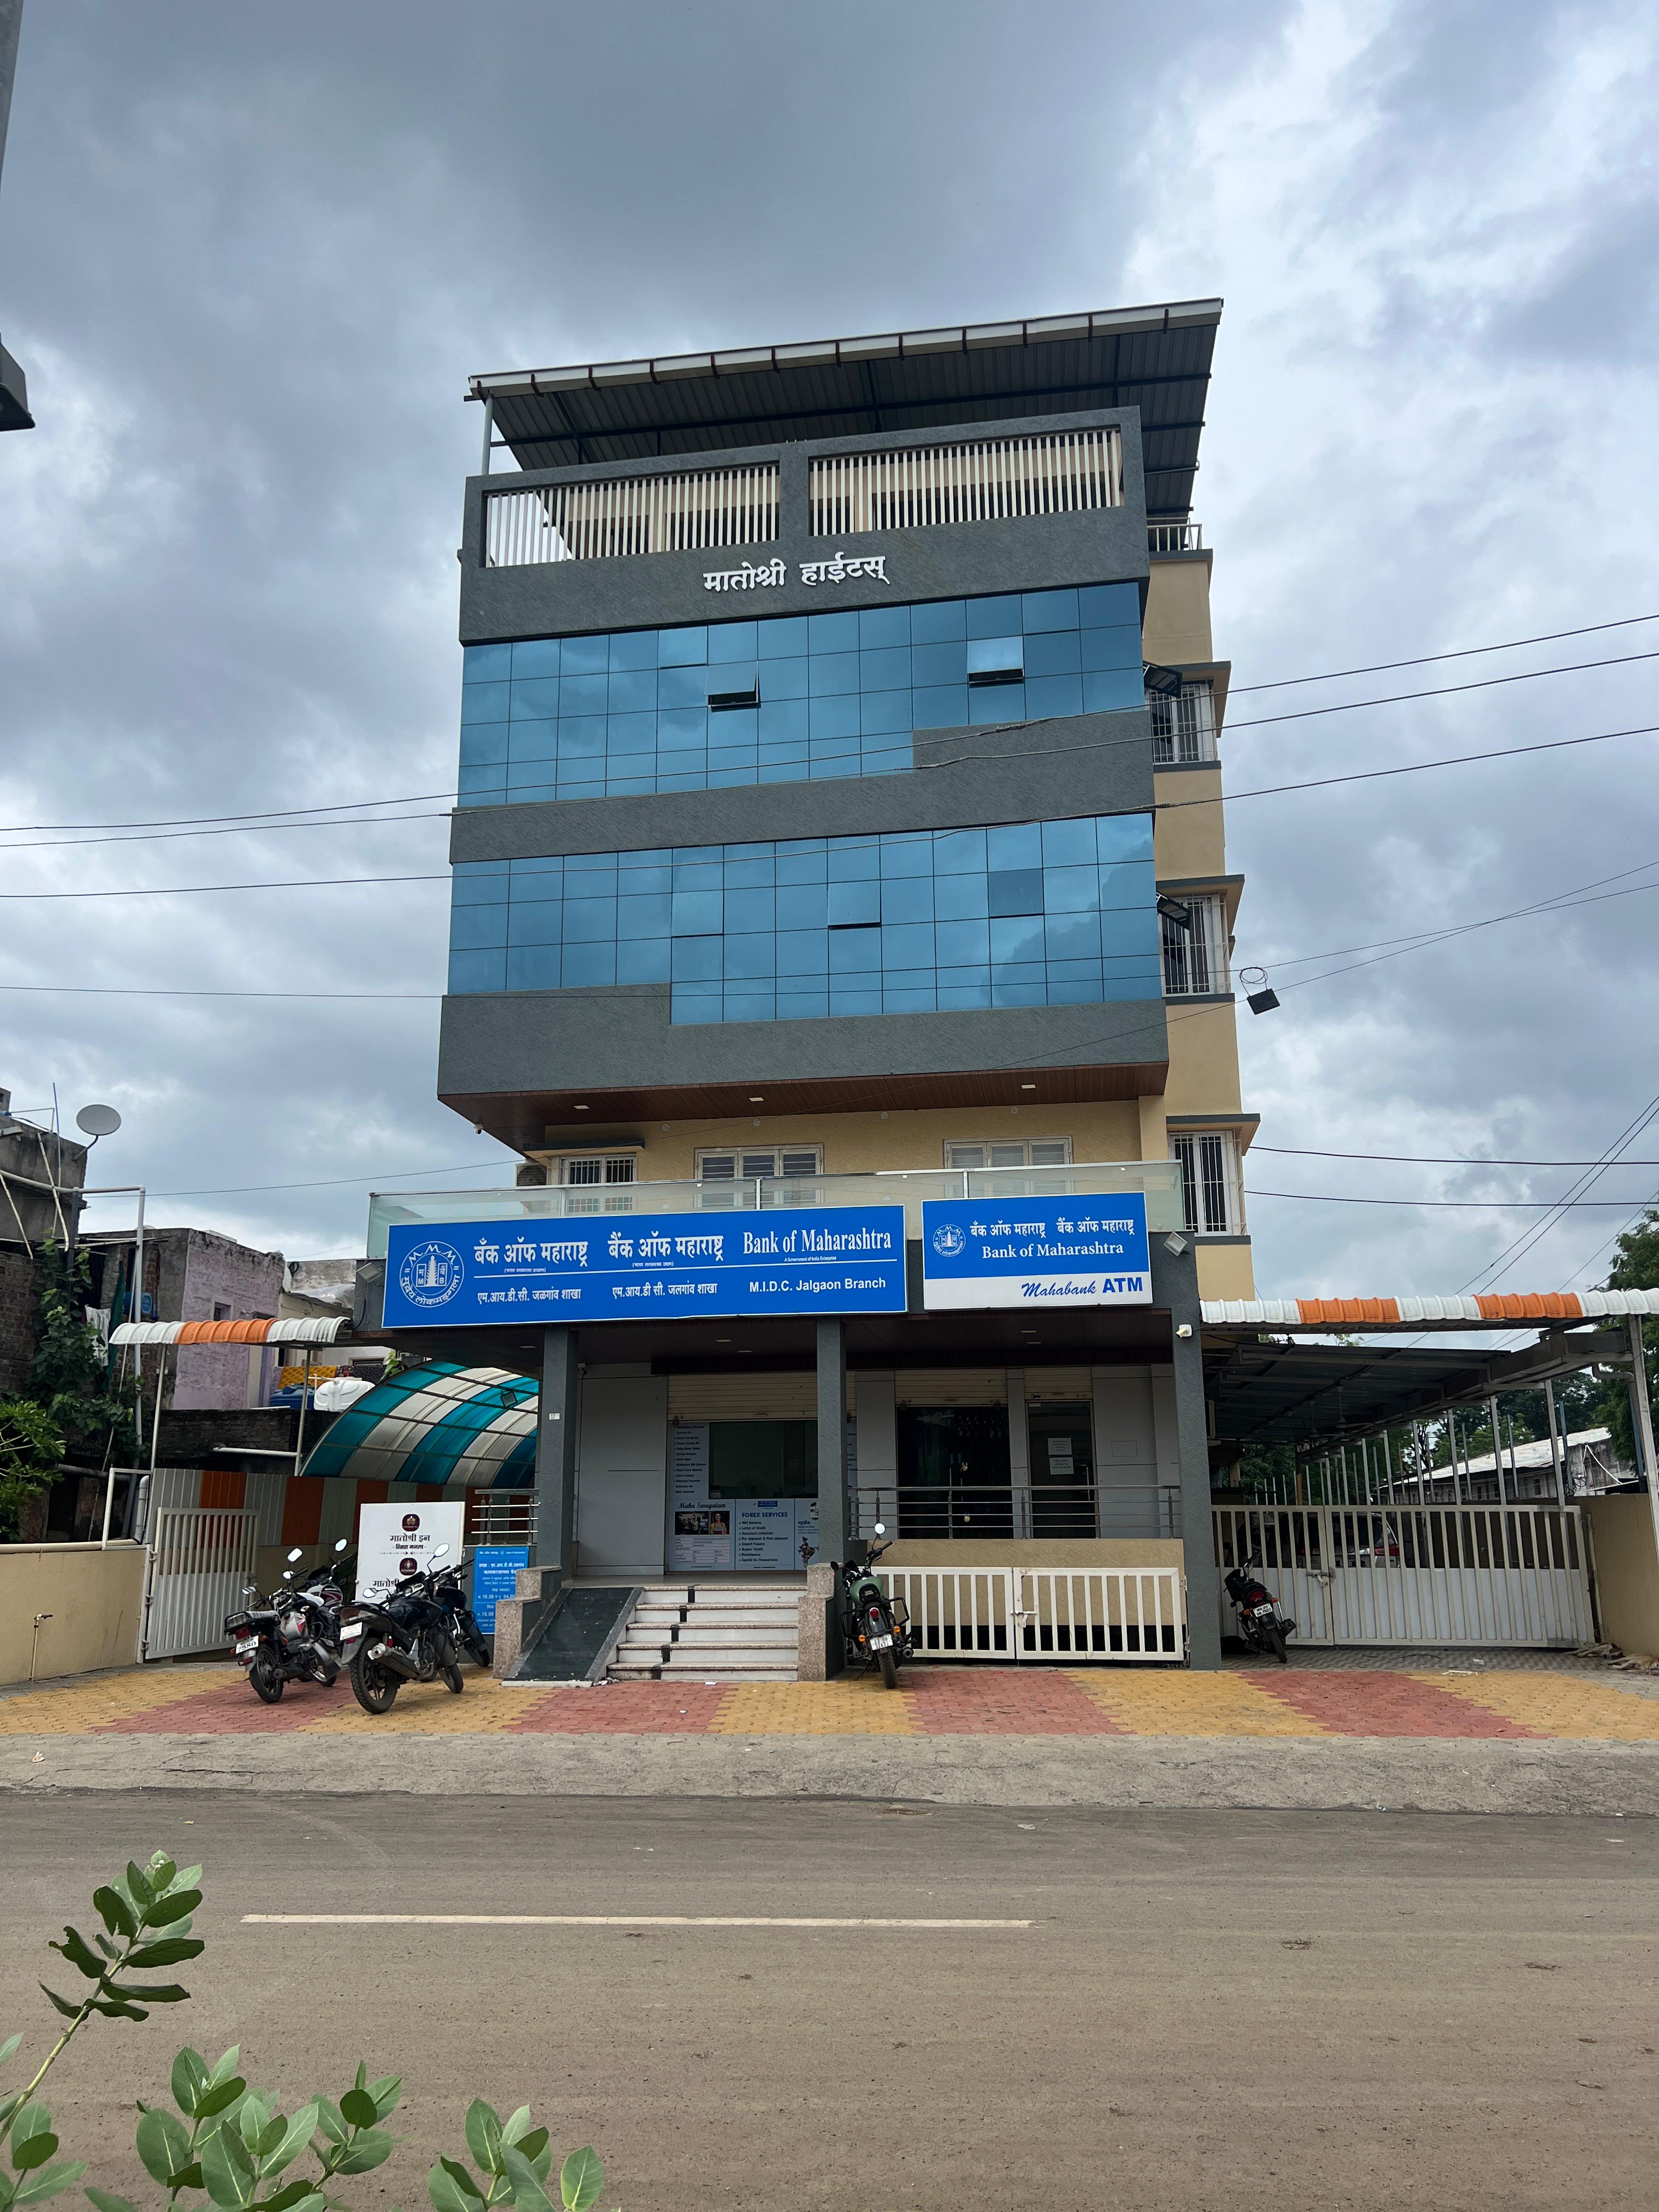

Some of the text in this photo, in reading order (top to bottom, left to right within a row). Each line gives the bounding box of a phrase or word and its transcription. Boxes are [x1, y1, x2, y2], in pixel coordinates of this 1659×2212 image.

[703, 558, 787, 592] मातोश्री
[990, 1220, 1012, 1235] ऑफ
[1013, 1222, 1047, 1239] महाराष्ट्र
[1056, 1216, 1135, 1236] बैंक ऑफ महाराष्ट्र
[607, 1230, 724, 1262] बैंक ऑफ महाराष्ट्र
[743, 1227, 891, 1254] Bank of Maharashtra
[504, 1236, 537, 1263] ऑफ
[540, 1241, 589, 1267] महाराष्ट्र
[982, 1242, 1124, 1259] Bank of Maharashtra
[668, 1280, 695, 1295] जलगांव
[697, 1283, 718, 1294] शाखा
[749, 1277, 886, 1293] M.I.D.C. Jalgaon Branch
[1021, 1277, 1143, 1297] Mahabank ATM
[477, 1287, 529, 1305] एम.आय.डी.सी.
[561, 1289, 582, 1299] शाखा
[390, 1533, 416, 1542] मातोश्री
